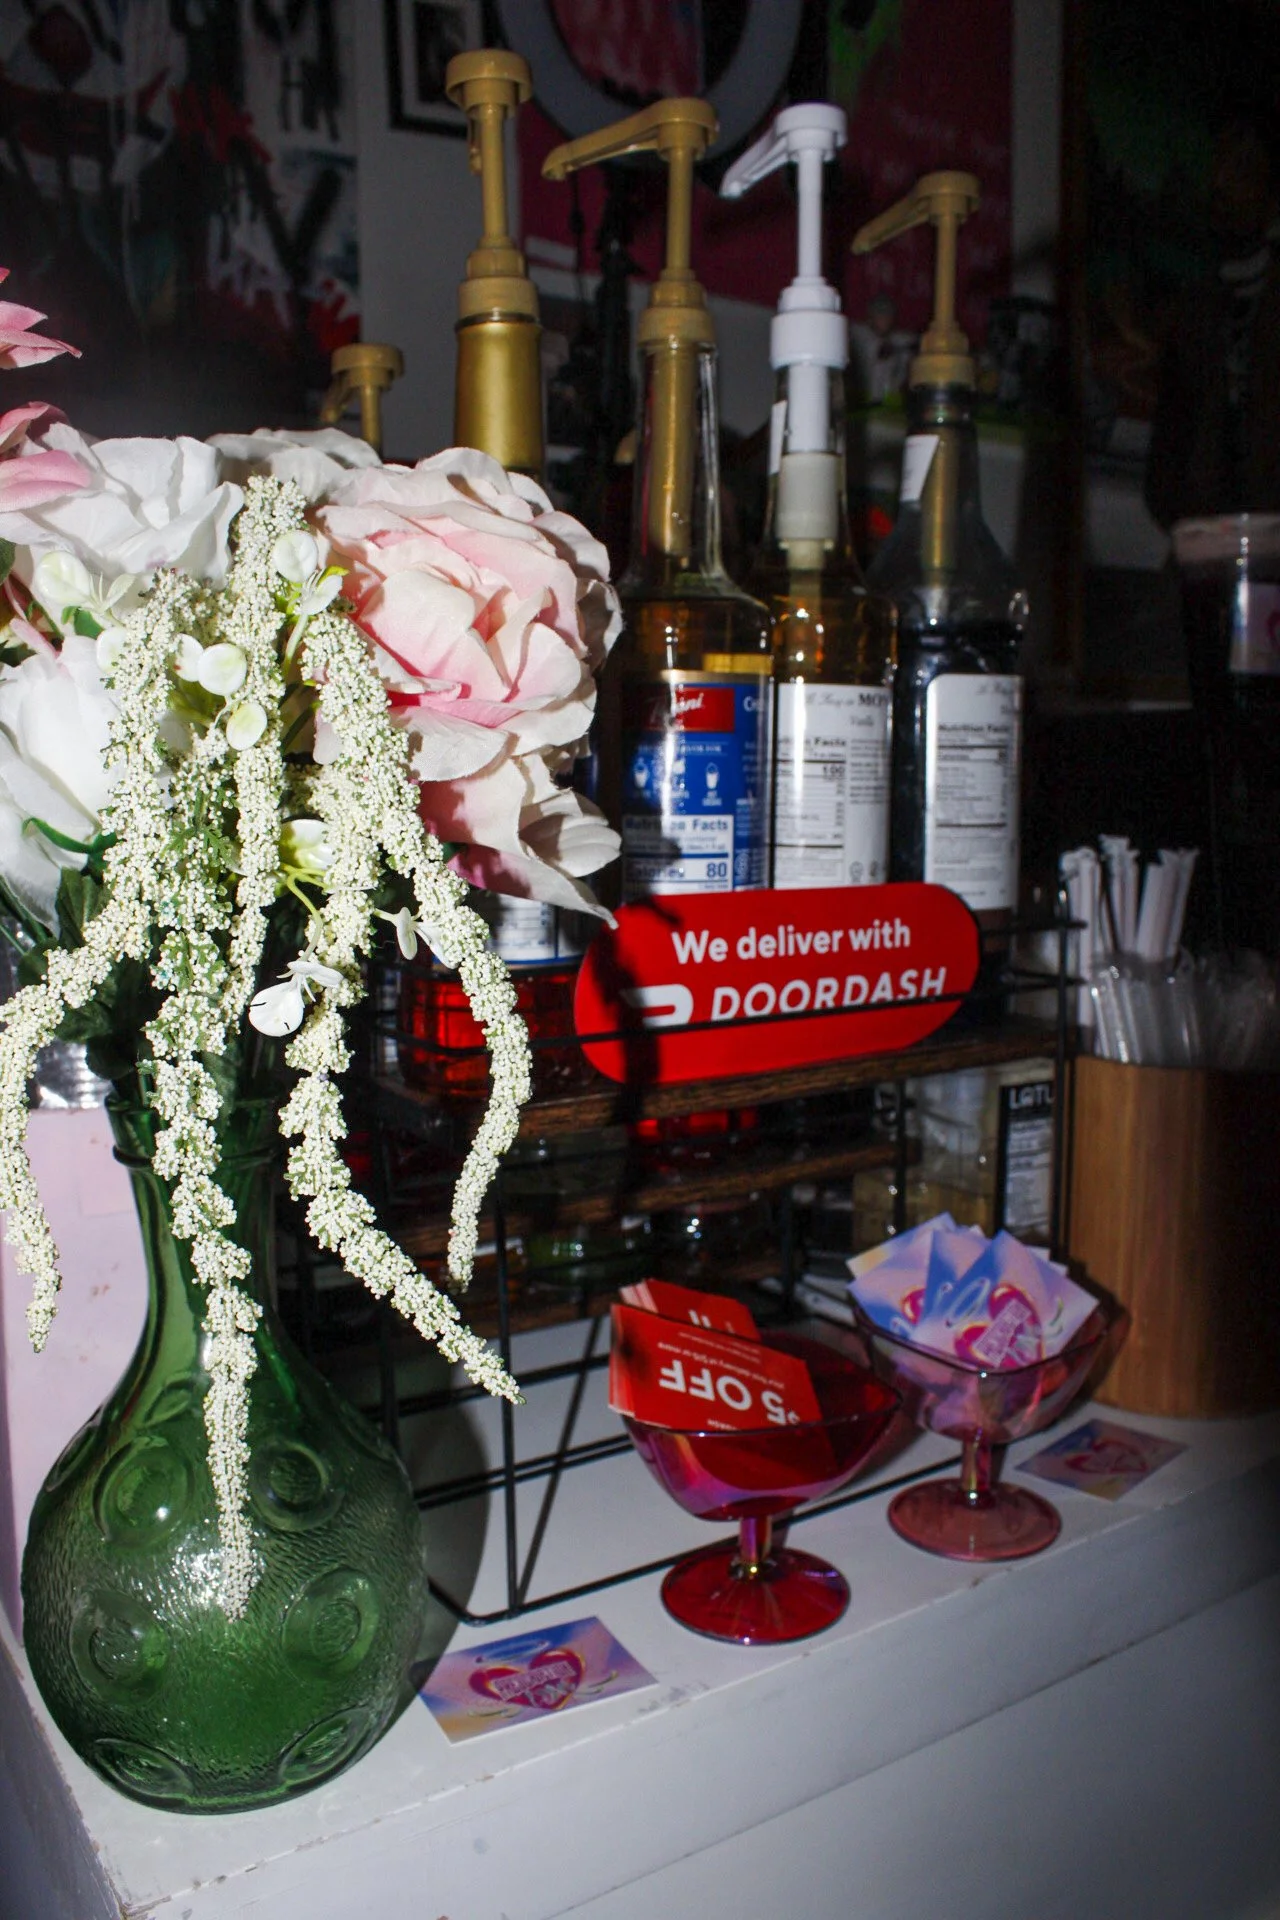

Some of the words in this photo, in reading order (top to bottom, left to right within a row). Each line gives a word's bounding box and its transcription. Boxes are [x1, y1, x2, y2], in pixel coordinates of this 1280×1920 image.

[692, 818, 729, 832] Facts
[706, 862, 728, 878] 80
[671, 930, 728, 965] We
[736, 926, 844, 960] deliver
[848, 917, 912, 951] with
[710, 966, 948, 1023] DOORDASH
[658, 1359, 753, 1412] OFF
